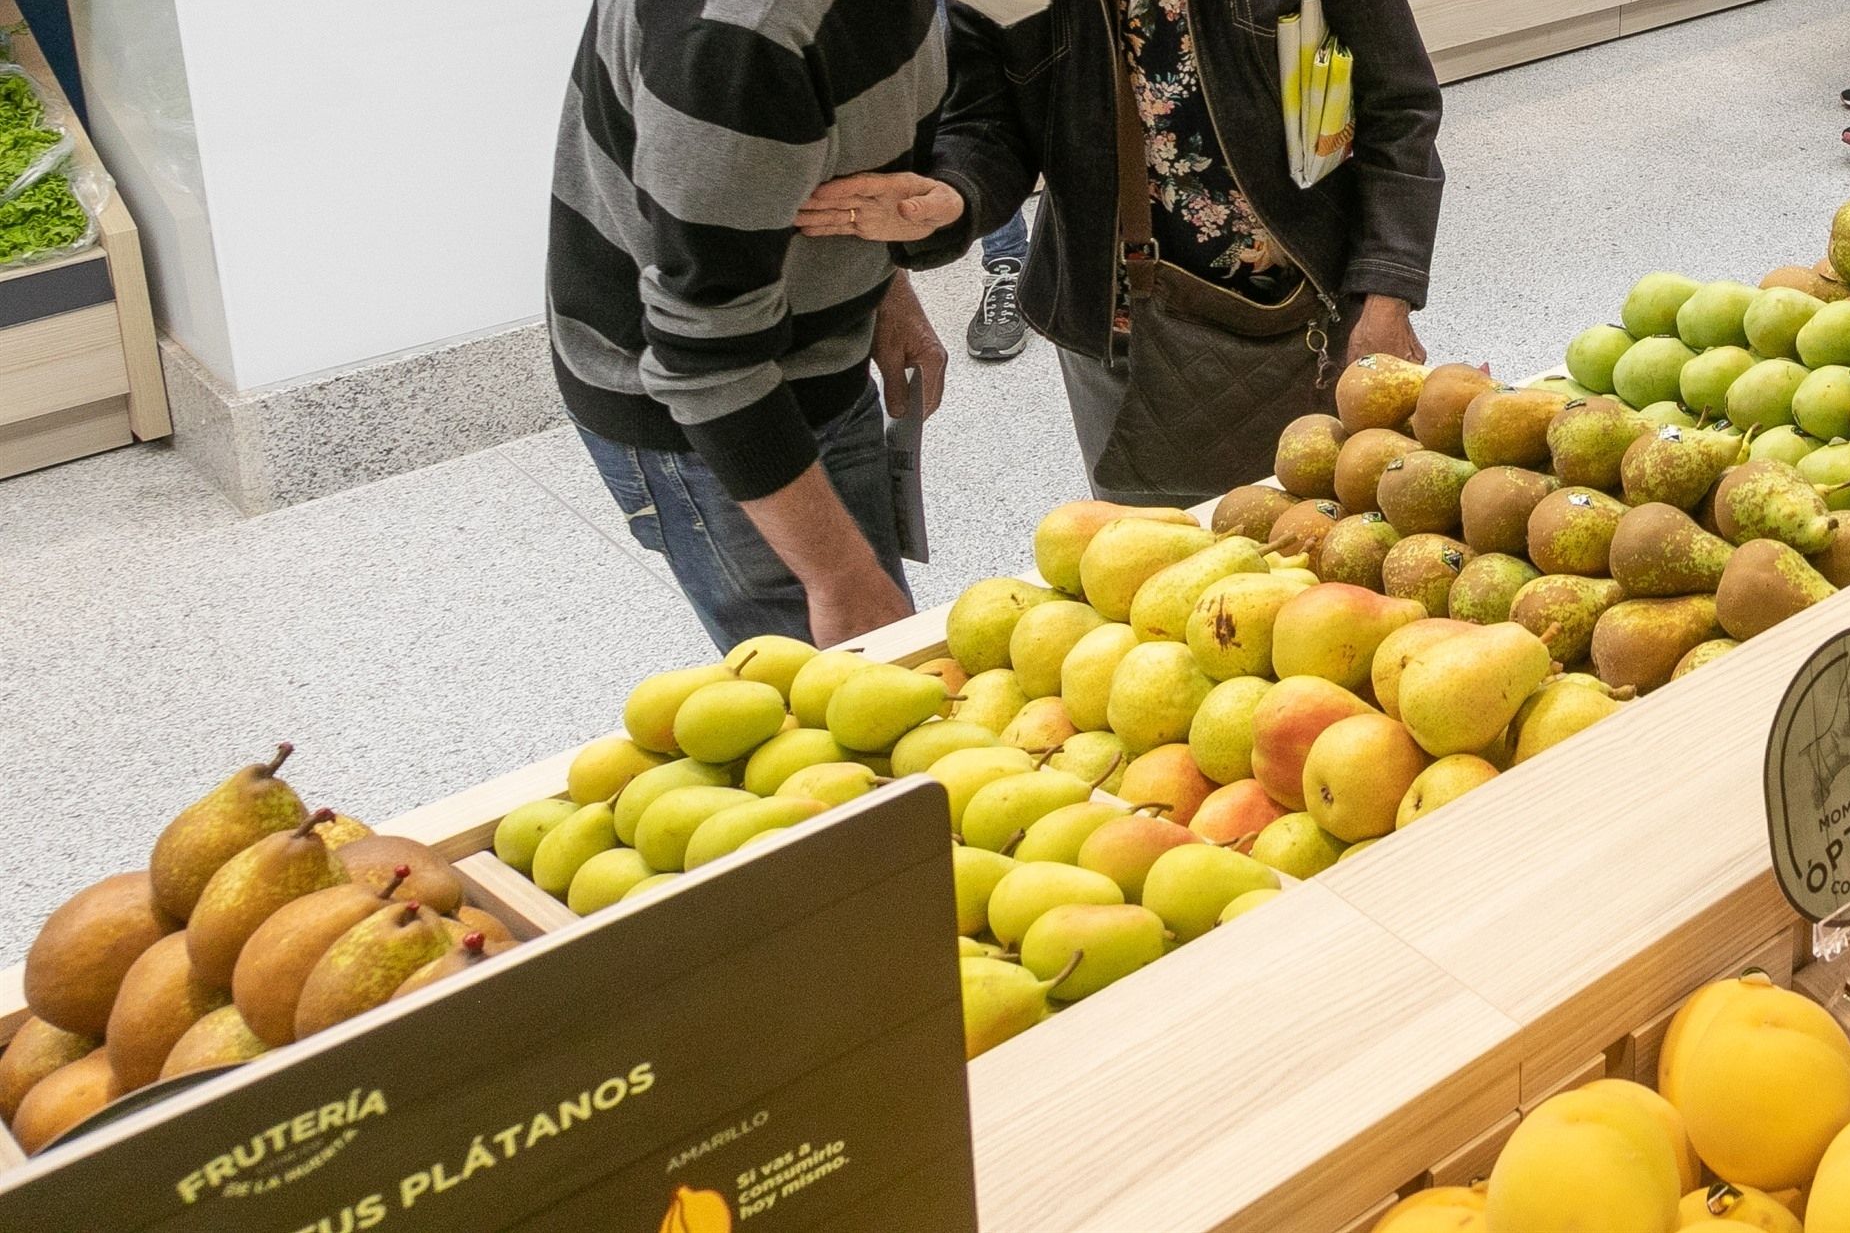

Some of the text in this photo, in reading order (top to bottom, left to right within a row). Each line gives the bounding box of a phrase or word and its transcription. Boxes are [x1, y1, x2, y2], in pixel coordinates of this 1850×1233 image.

[176, 1087, 389, 1205] FRUTERÍA
[400, 1061, 656, 1209] PLÁTANOS
[666, 1110, 770, 1175] AMARILLO
[760, 1150, 795, 1176] vas
[798, 1141, 811, 1158] a
[738, 1139, 846, 1204] consumirlo
[738, 1155, 850, 1221] hoy mismo.
